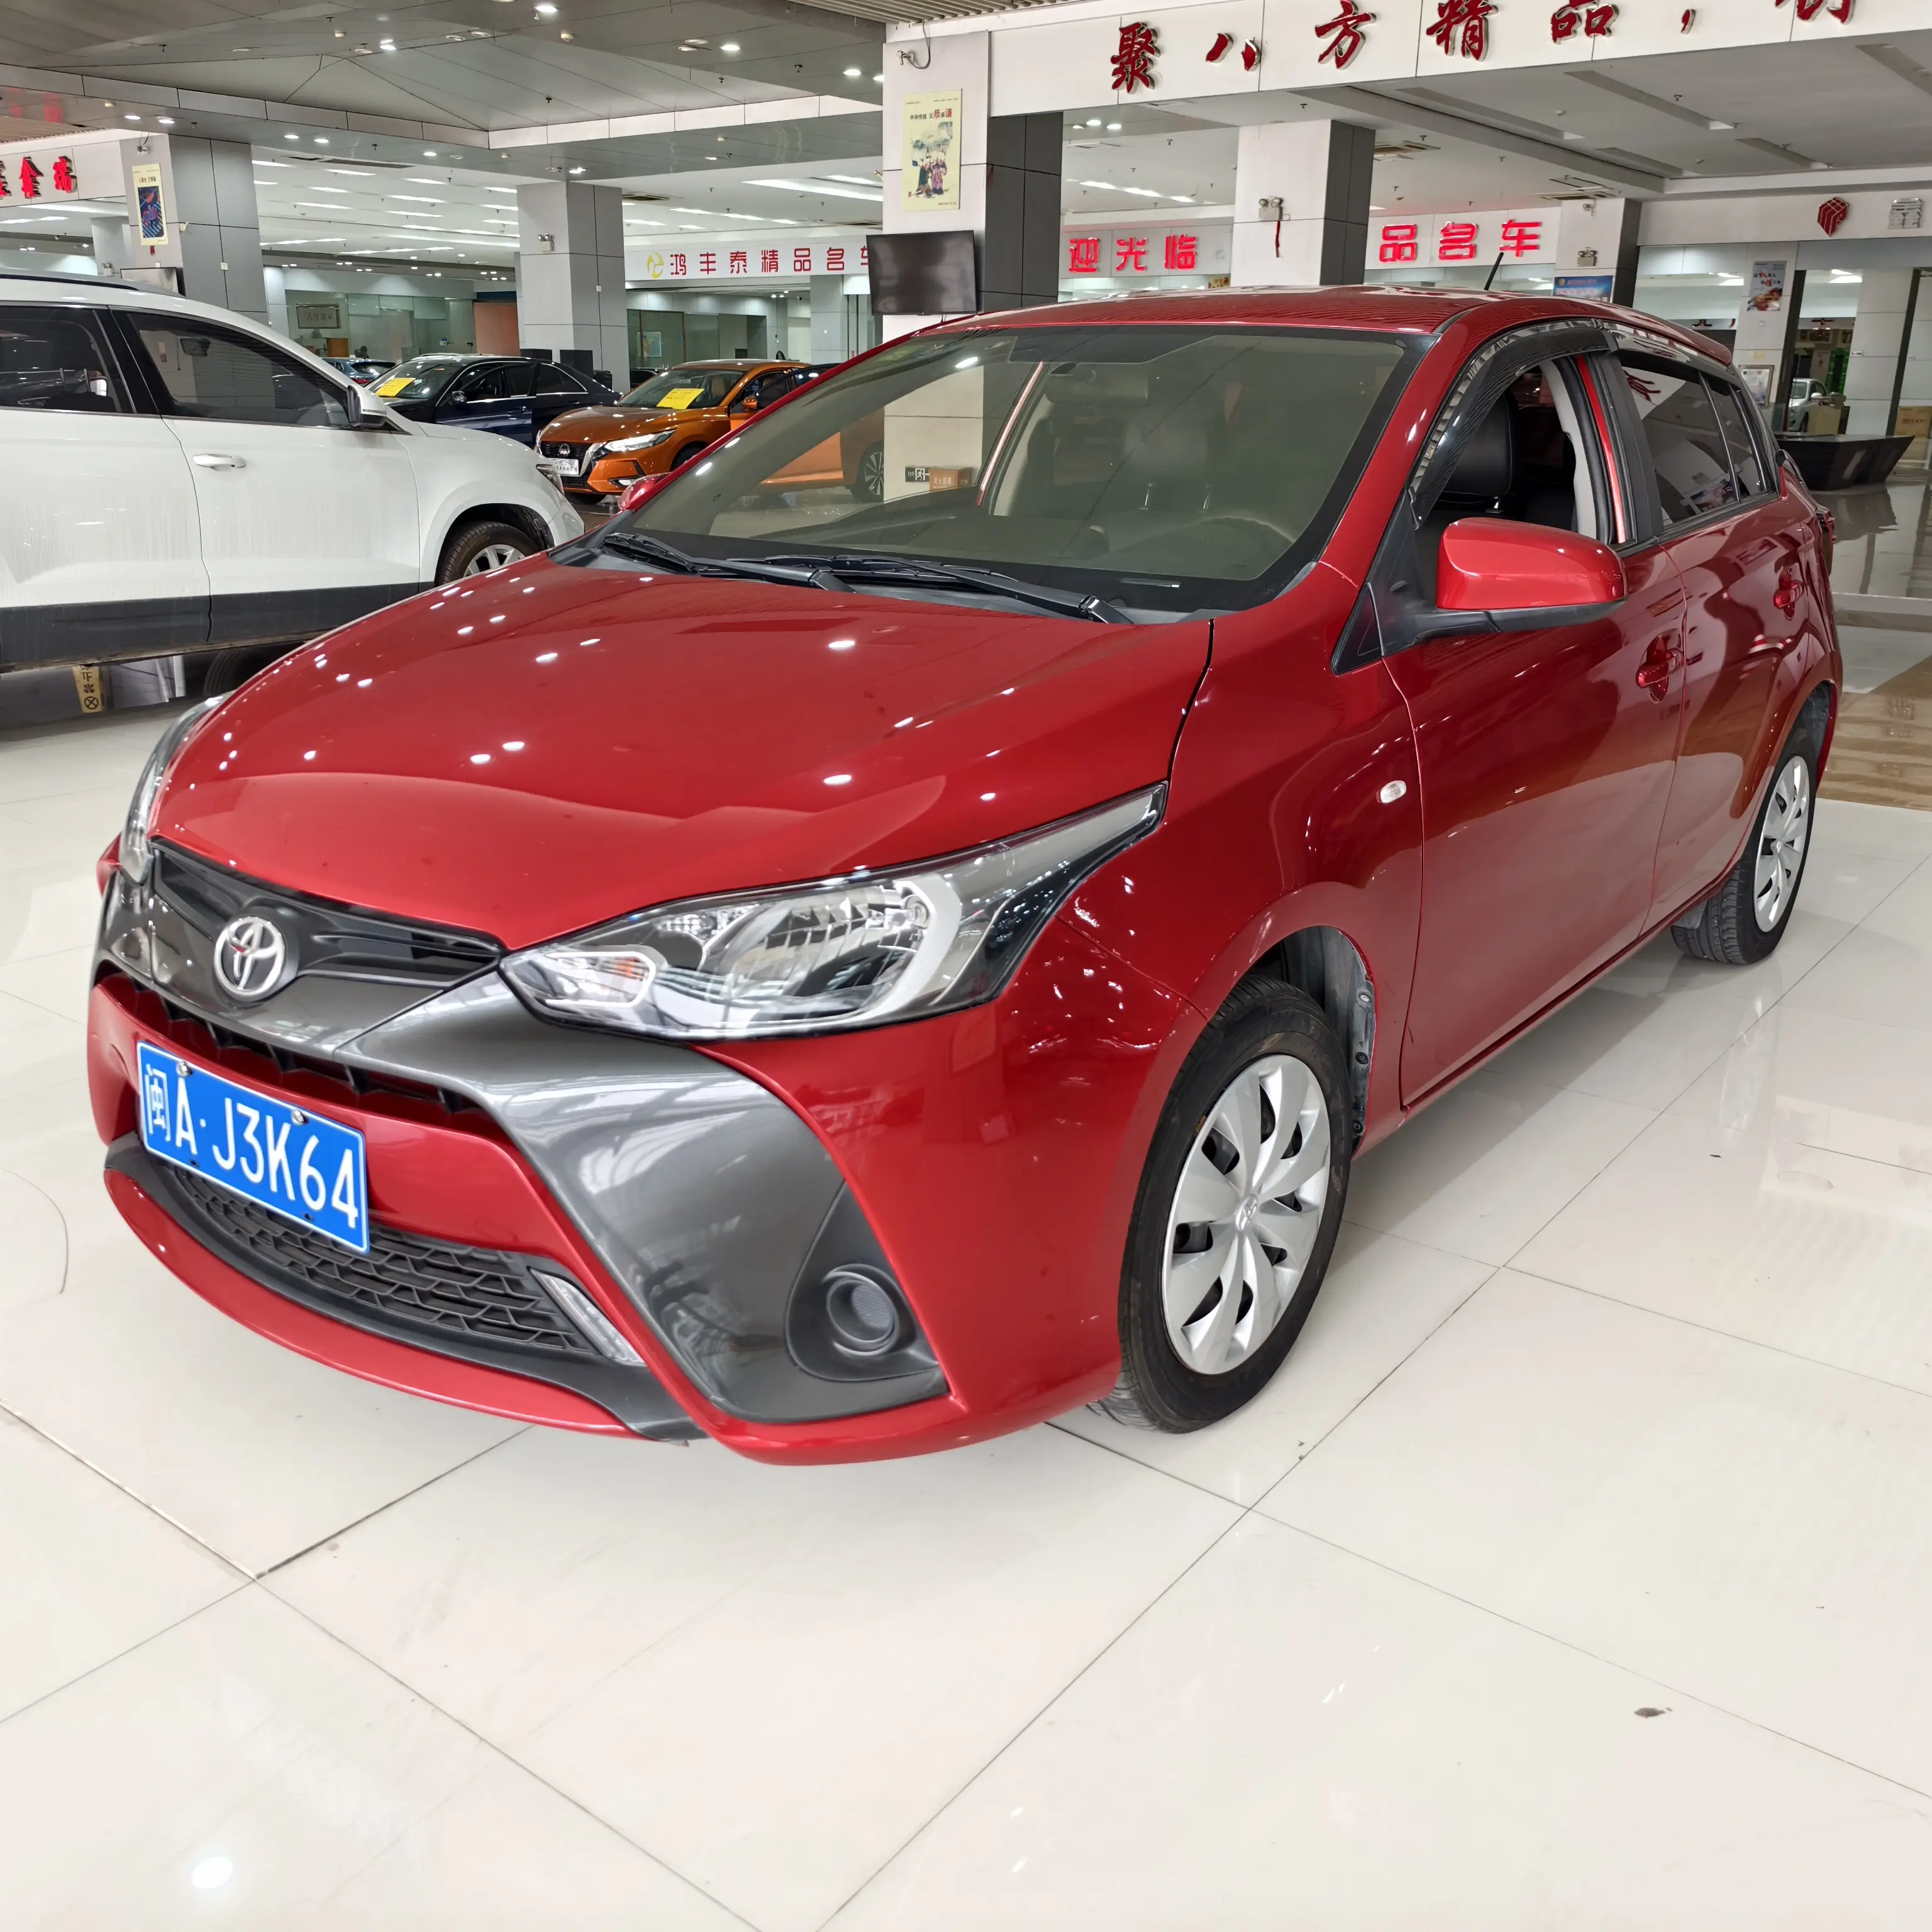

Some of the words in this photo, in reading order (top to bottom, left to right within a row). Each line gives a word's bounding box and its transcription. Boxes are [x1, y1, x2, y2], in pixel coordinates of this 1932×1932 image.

[1069, 234, 1198, 273] 迎光临
[1379, 219, 1543, 263] 品名车
